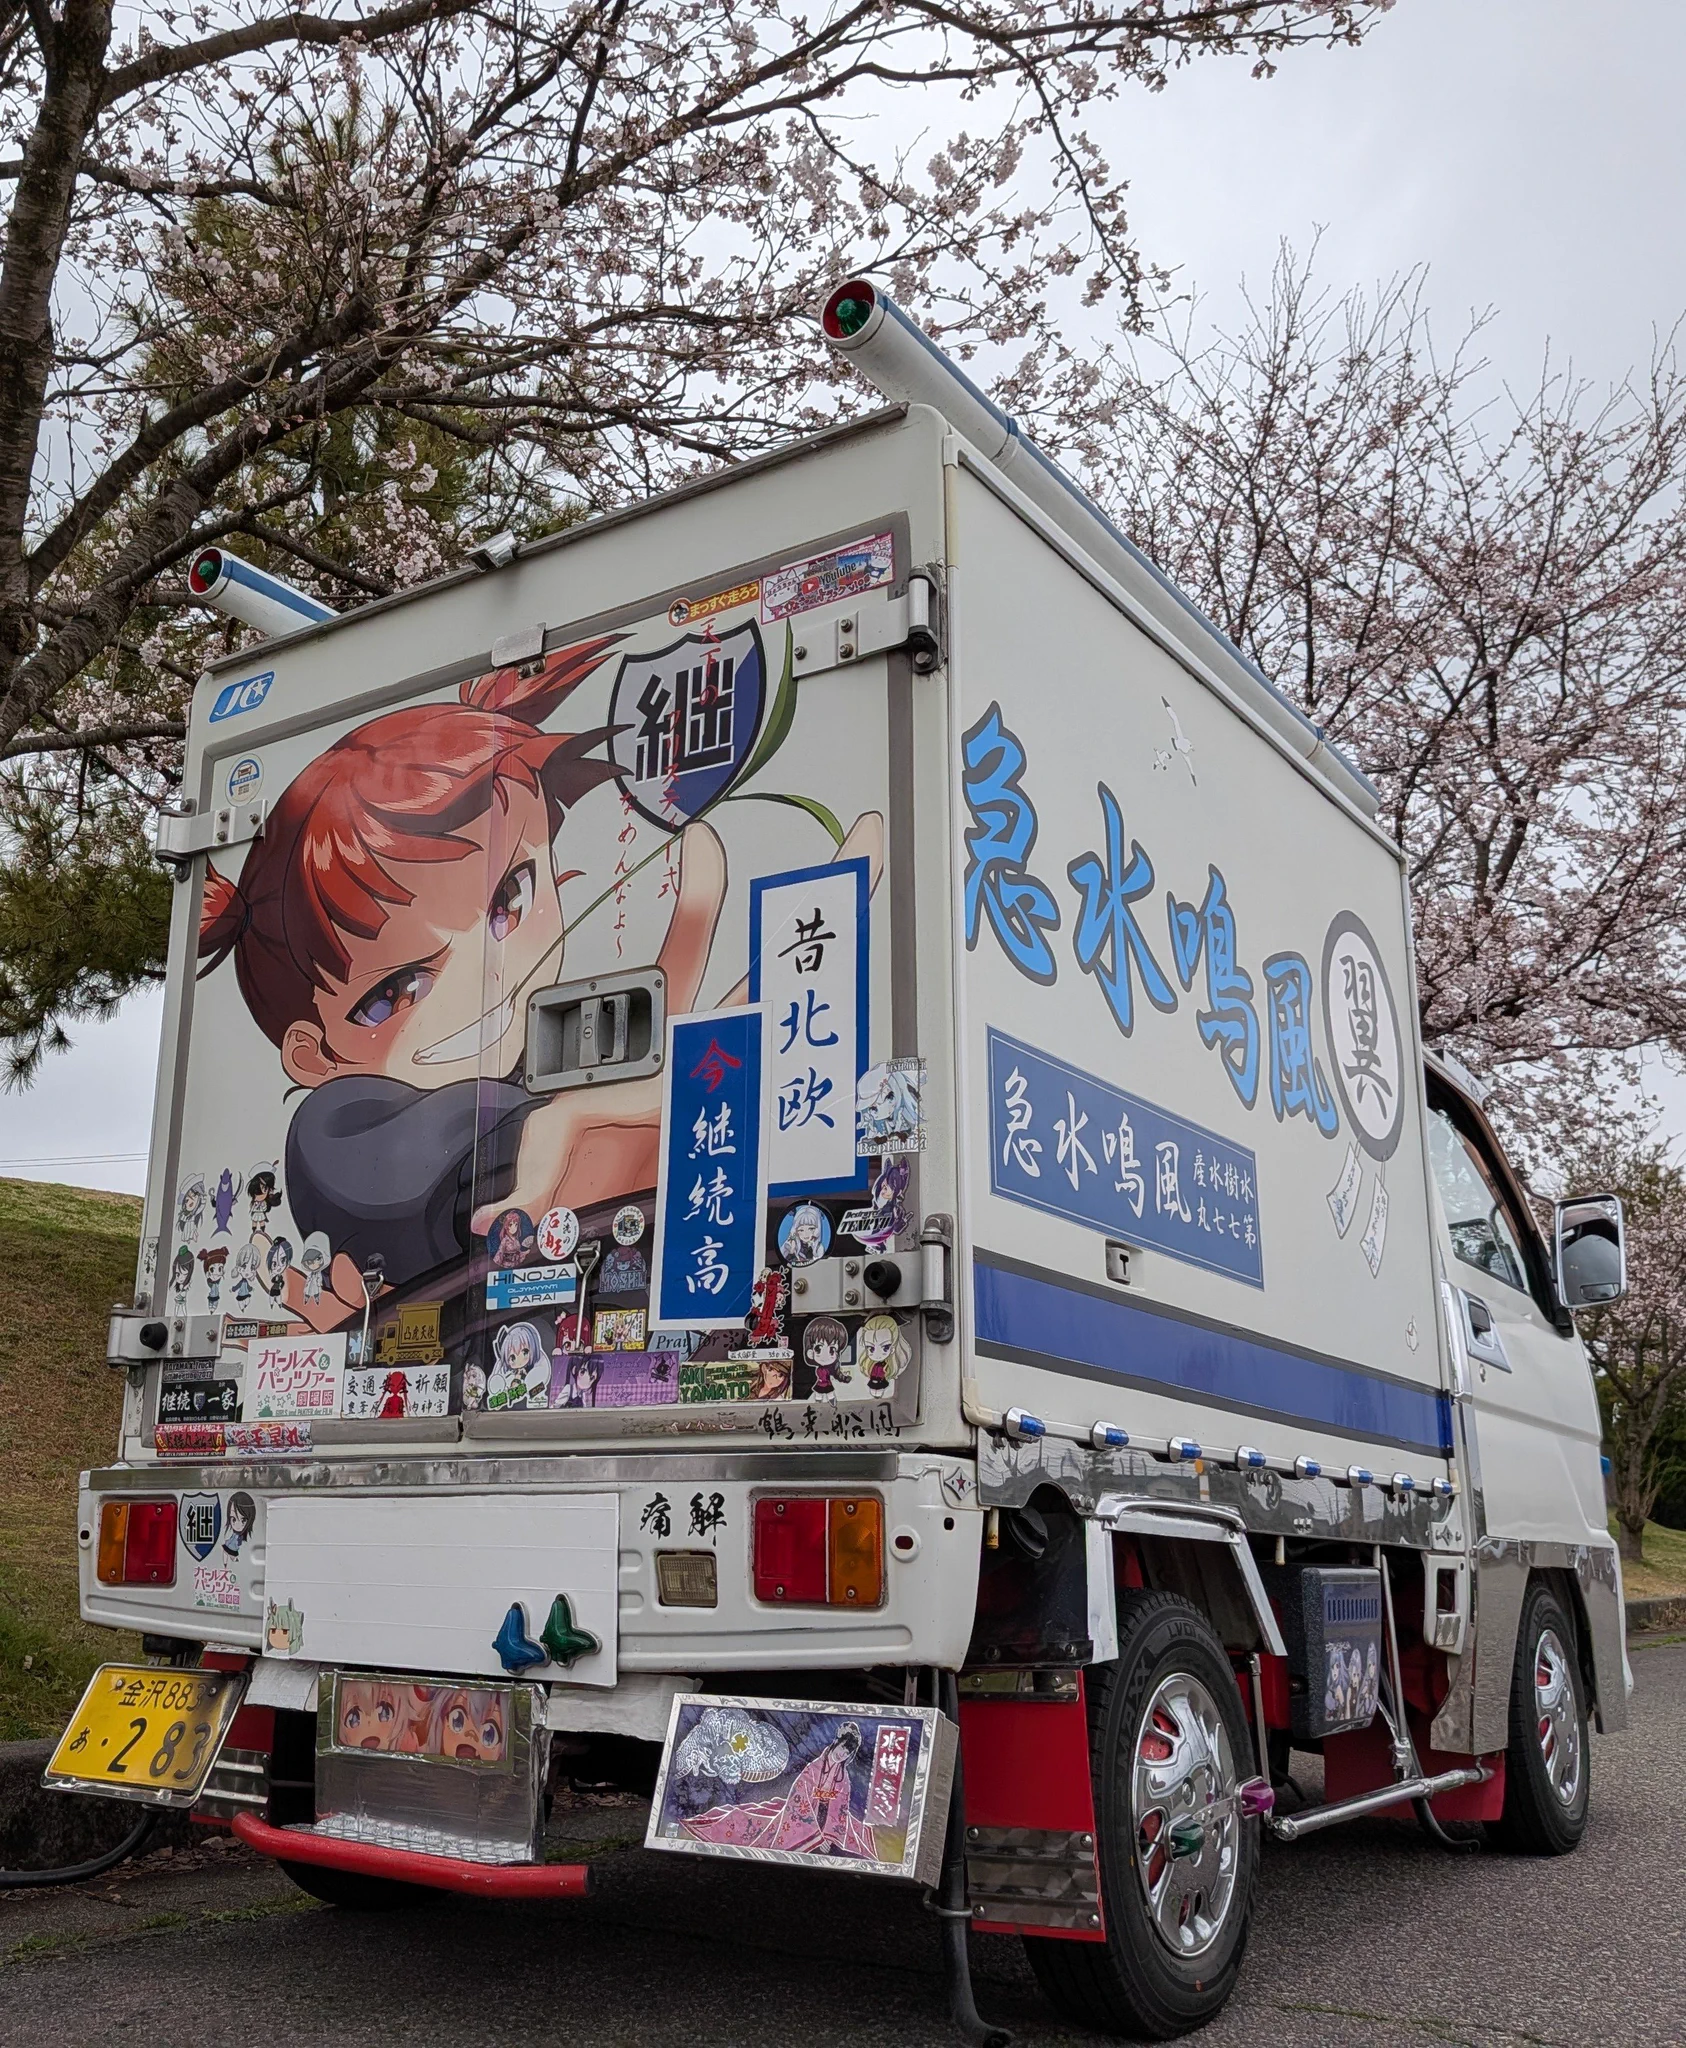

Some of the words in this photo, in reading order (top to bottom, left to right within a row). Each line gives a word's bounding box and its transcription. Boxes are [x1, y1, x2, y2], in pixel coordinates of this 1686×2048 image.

[820, 562, 857, 584] YouTube
[777, 907, 839, 1133] 昔北欧
[681, 1037, 744, 1297] 今継続高
[493, 1268, 571, 1286] HINOJA
[508, 1292, 556, 1305] OARAI
[257, 1347, 324, 1372] ガールズ
[257, 1370, 335, 1393] パンツァー
[680, 1367, 705, 1385] AKI
[680, 1382, 750, 1402] YAMATO
[69, 1726, 91, 1754] あ
